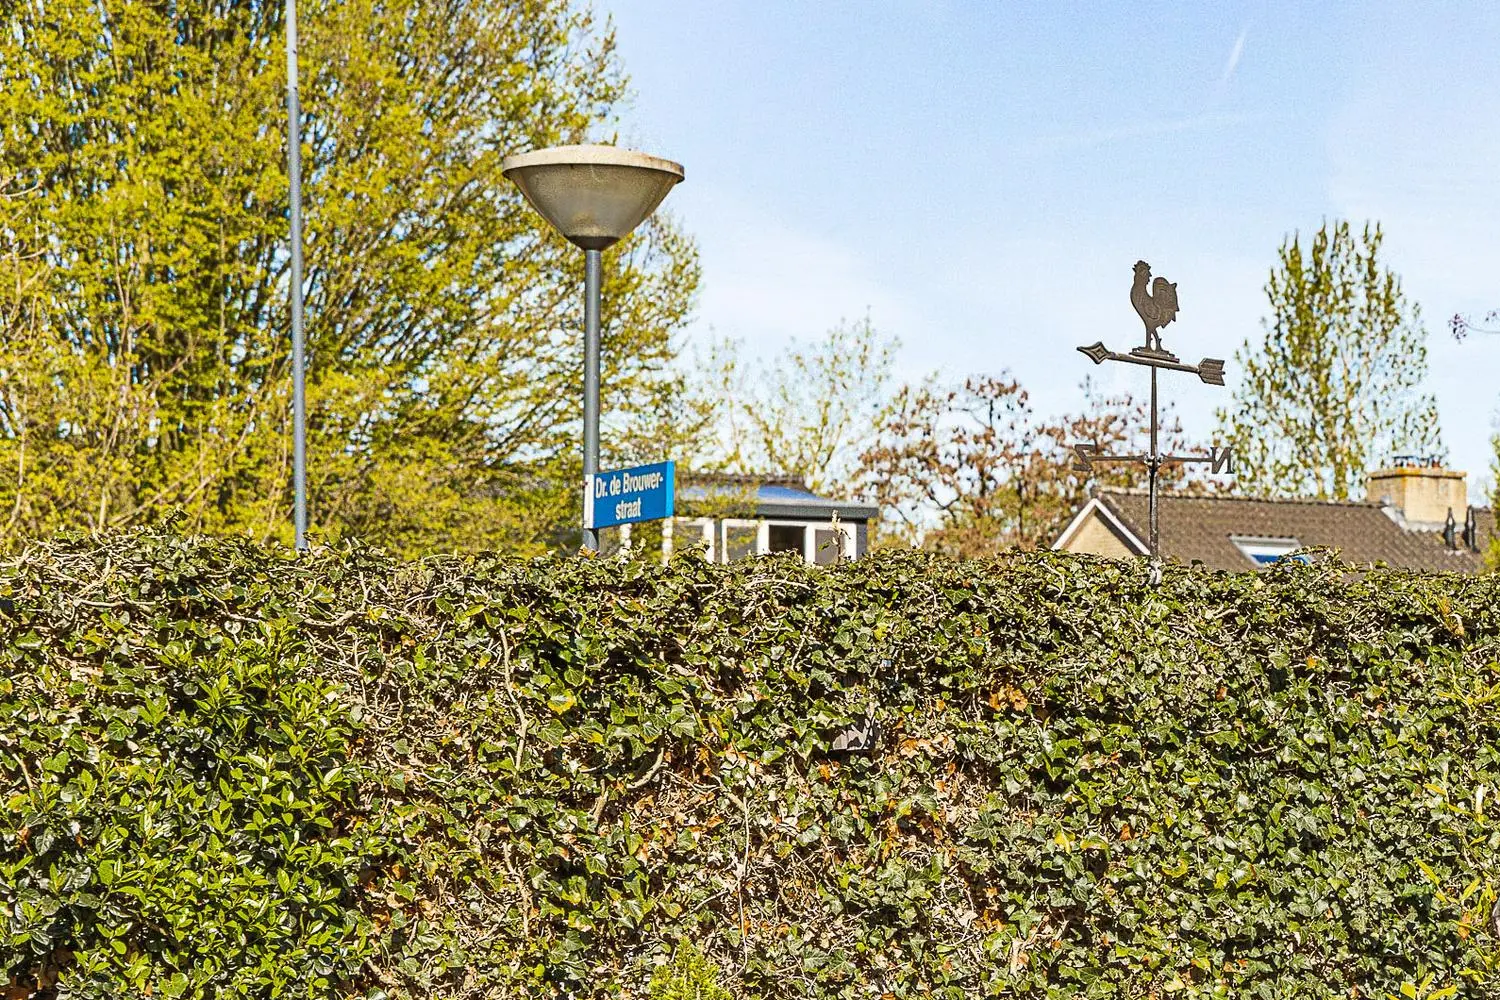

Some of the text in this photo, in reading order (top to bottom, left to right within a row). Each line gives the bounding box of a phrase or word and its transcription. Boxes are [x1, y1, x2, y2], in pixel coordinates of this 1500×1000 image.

[595, 472, 664, 499] Dr. de Brouwer-
[615, 497, 642, 520] straat
